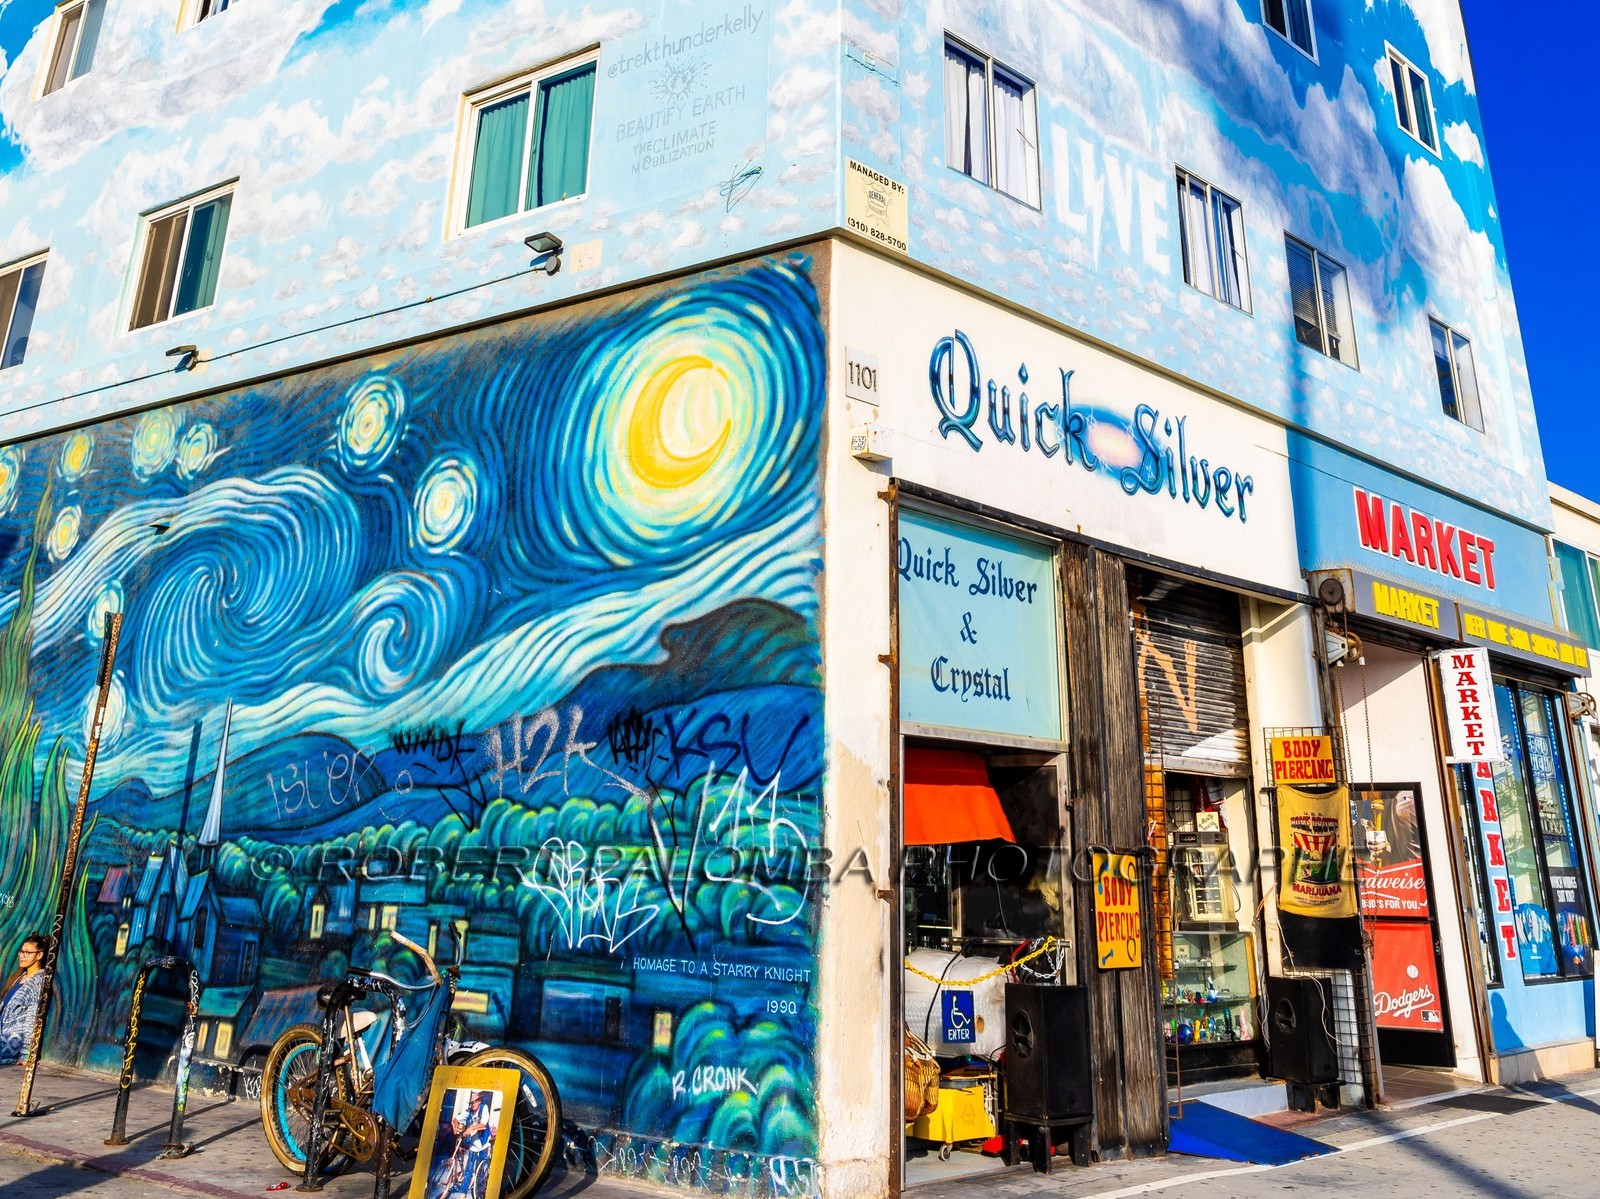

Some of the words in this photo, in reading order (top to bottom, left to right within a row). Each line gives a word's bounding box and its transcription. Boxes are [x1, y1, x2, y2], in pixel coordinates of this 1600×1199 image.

[607, 3, 764, 79] @trekthunderkelly
[616, 102, 686, 142] BEAUTIFY
[691, 83, 746, 116] EARTH
[651, 120, 717, 154] CLIMATE
[850, 160, 890, 187] MANAGED
[891, 181, 905, 195] BY:
[847, 216, 869, 233] (310)
[870, 228, 907, 251] 828-5700
[848, 361, 877, 393] 1101
[928, 328, 1098, 473] Quick
[1119, 403, 1254, 524] Silver
[1354, 488, 1496, 591] MARKET
[898, 536, 960, 588] Quick
[969, 557, 1038, 605] Silver
[1372, 580, 1440, 630] MARKET
[959, 611, 978, 645] &
[930, 654, 1012, 703] Crystal
[1451, 653, 1485, 756] MARKET
[1282, 739, 1321, 759] BODY
[1274, 758, 1334, 780] PIERCING
[1475, 762, 1517, 960] ARKET
[1103, 875, 1133, 907] BODY
[1292, 882, 1343, 897] MARIJUANA
[1384, 899, 1401, 910] FOR
[1401, 899, 1421, 910] YOU.
[1097, 911, 1141, 943] PIERCING
[632, 956, 677, 972] HOMAGE
[680, 960, 696, 974] TO
[699, 961, 708, 975] A
[713, 962, 760, 979] STARRY
[764, 966, 811, 983] KNIGHT
[766, 1000, 797, 1015] 1990
[1374, 984, 1436, 1018] Dodgers
[947, 1028, 970, 1041] ENTER
[691, 1065, 758, 1097] CRONK
